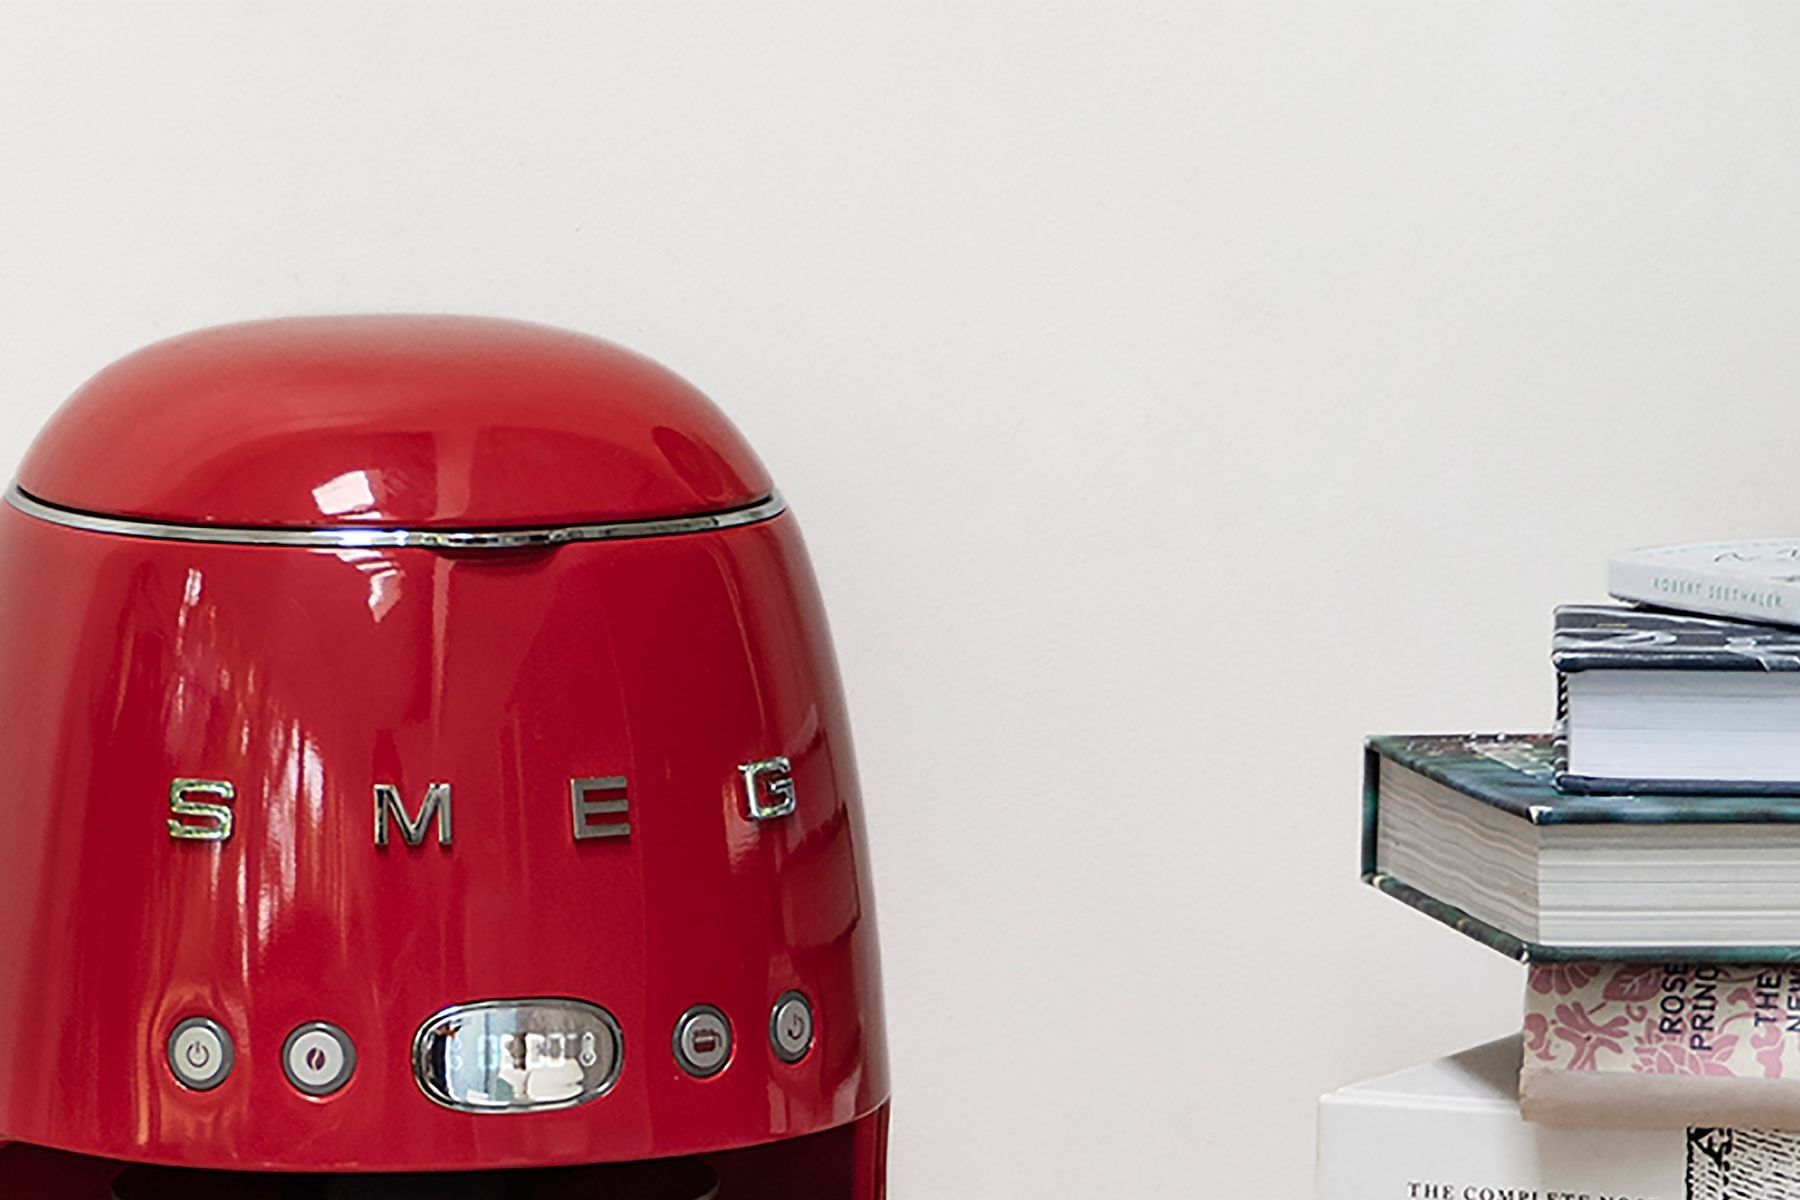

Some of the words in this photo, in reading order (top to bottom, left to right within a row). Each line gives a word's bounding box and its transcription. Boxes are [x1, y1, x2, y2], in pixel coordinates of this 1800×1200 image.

[1653, 577, 1701, 594] ROBERT
[1708, 585, 1783, 608] SEETHALER
[167, 756, 796, 847] SMEG
[1754, 973, 1782, 1027] THE
